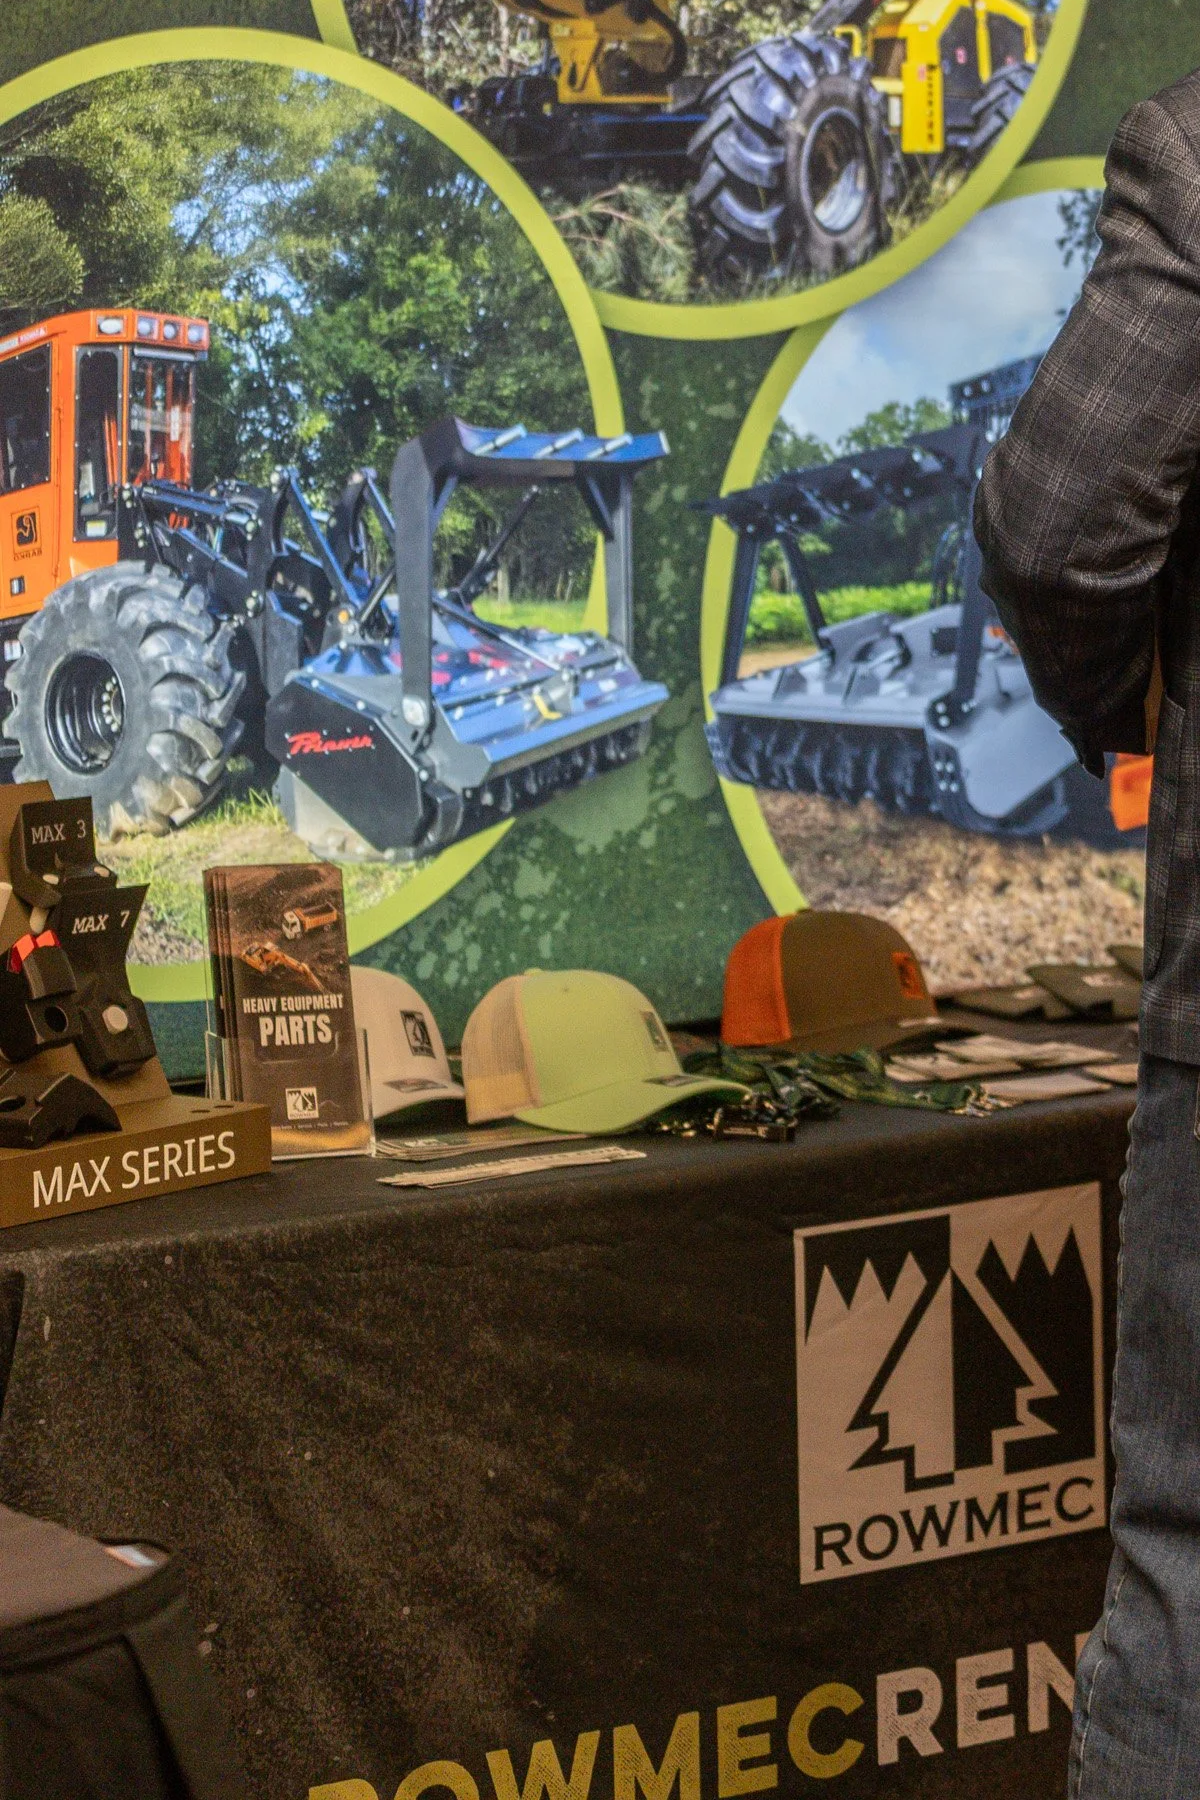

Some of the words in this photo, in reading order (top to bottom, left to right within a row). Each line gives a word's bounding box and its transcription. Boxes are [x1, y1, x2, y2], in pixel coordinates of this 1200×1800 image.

[31, 823, 66, 845] MAX
[77, 819, 86, 838] 3
[71, 914, 109, 934] MAX
[120, 910, 130, 928] 7
[243, 997, 277, 1014] HEAVY
[281, 993, 343, 1012] EQUIPMENT
[259, 1013, 332, 1047] PARTS
[33, 1156, 112, 1209] MAX
[121, 1131, 236, 1190] SERIES
[813, 1476, 1095, 1571] ROWMEC
[309, 1632, 1091, 1800] WMECREN
